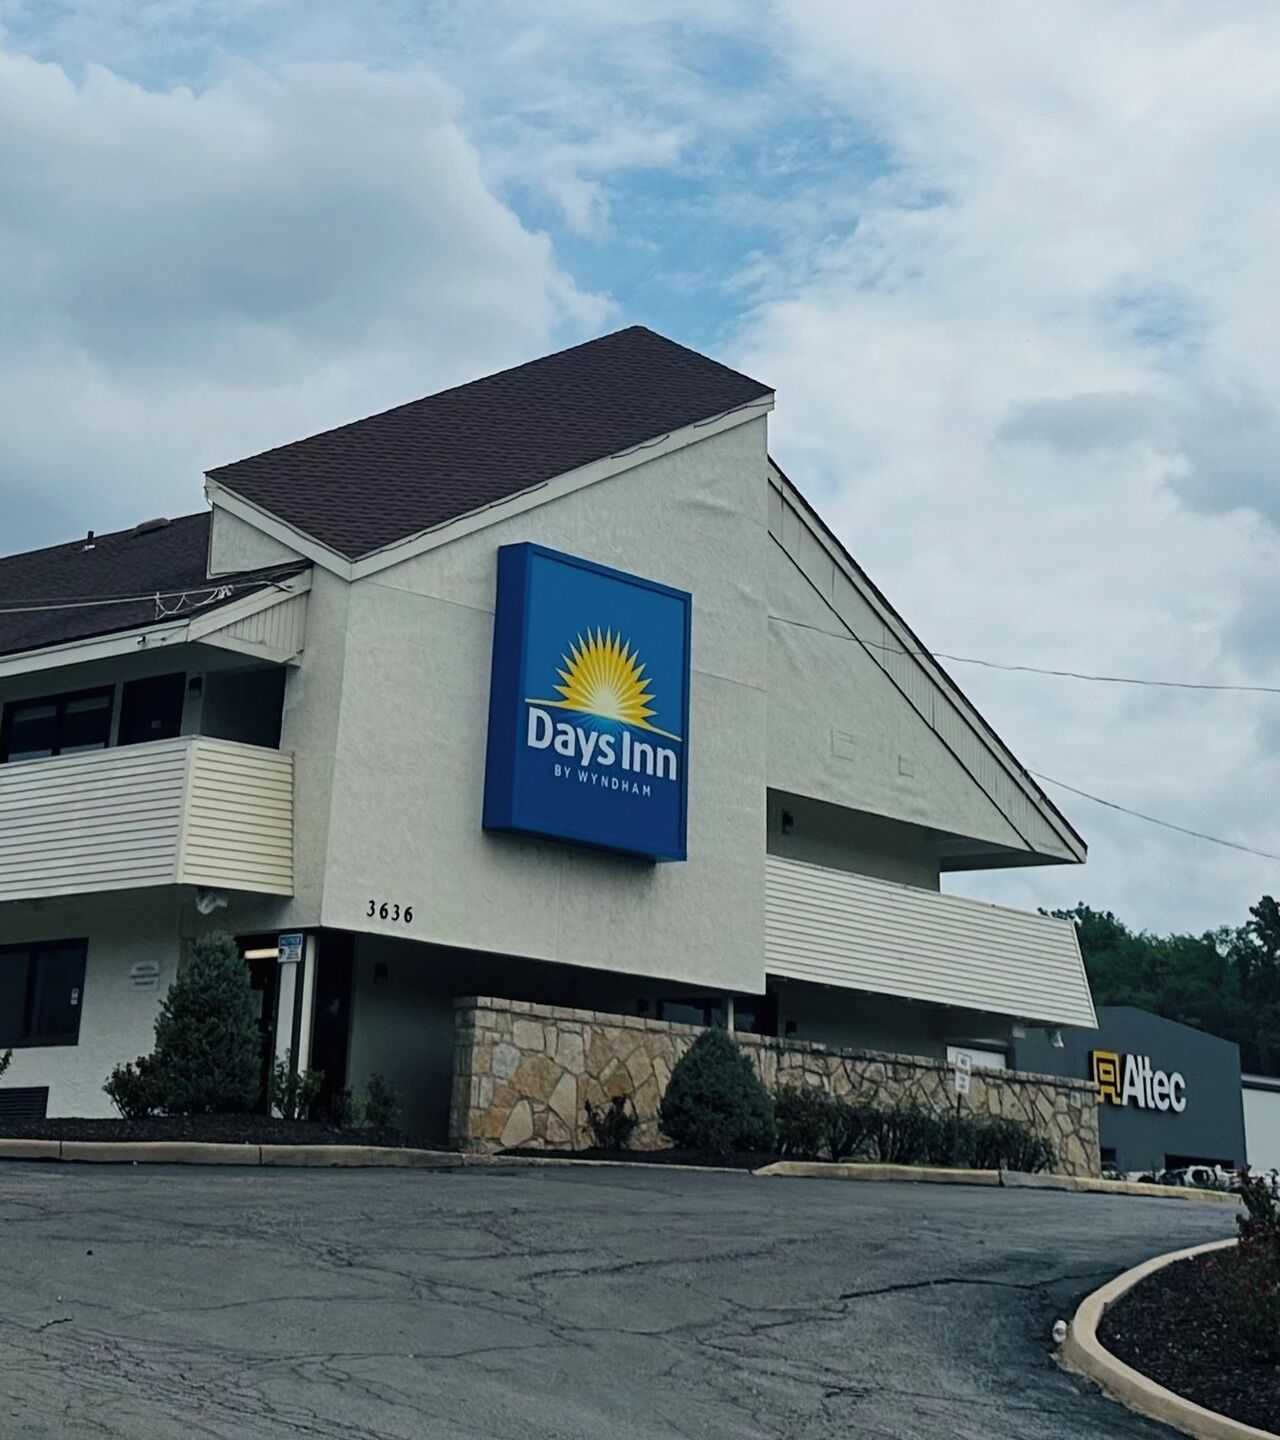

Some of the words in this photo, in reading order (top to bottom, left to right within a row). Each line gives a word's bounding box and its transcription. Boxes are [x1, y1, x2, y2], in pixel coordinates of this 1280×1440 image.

[527, 706, 616, 767] Days
[622, 731, 677, 780] Inn
[554, 763, 571, 779] BY
[578, 768, 652, 798] WYNDHAM
[366, 900, 414, 924] 3636
[1122, 1053, 1187, 1113] Altec
